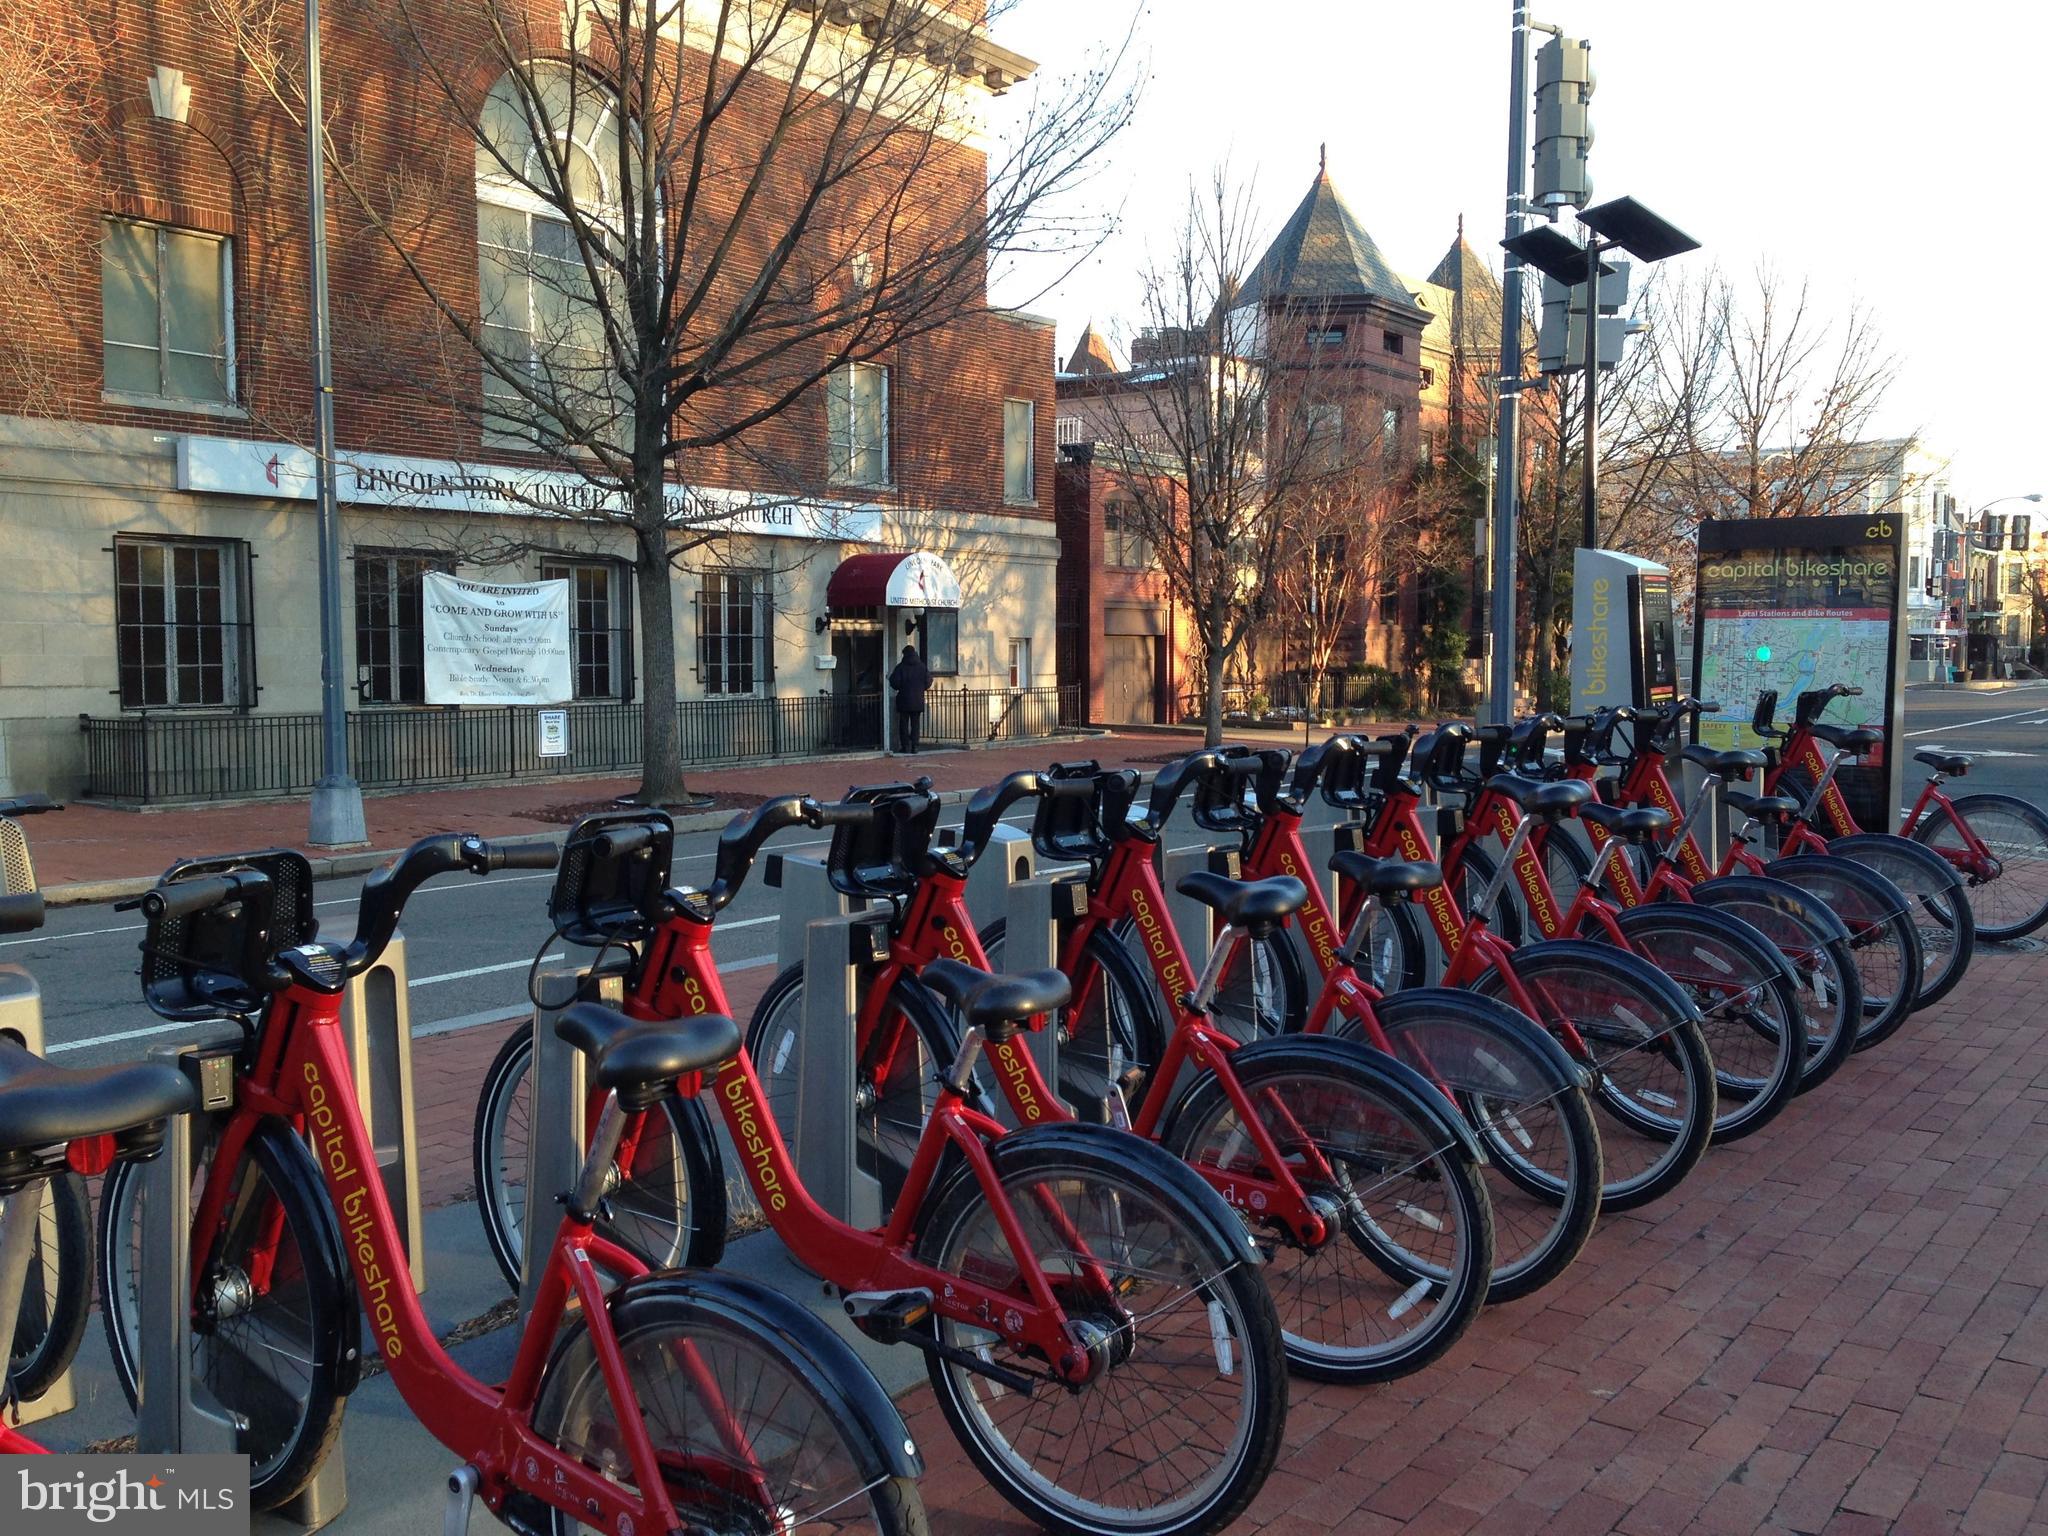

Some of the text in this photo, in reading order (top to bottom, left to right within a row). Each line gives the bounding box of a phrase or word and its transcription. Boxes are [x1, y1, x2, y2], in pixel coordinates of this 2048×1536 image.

[356, 467, 453, 497] LINCOLN
[468, 475, 523, 503] PARK
[534, 482, 605, 510] UNITED
[729, 502, 792, 526] CHURCH
[1706, 557, 1888, 582] capital bikeshare
[457, 582, 539, 595] YOU ARE INVITED
[890, 596, 908, 605] UNITED
[470, 607, 492, 617] AND
[493, 608, 523, 618] GROW
[524, 610, 547, 620] WITH
[1826, 609, 1854, 617] Routes
[484, 623, 519, 633] Sundays
[443, 632, 471, 642] Church
[502, 635, 512, 643] all
[1582, 577, 1609, 697] bikeshare
[427, 643, 480, 655] Contemporary
[482, 646, 508, 657] Gospel
[510, 647, 536, 658] Worship
[474, 663, 525, 673] Wednesdays
[493, 674, 514, 684] Noon
[1823, 785, 1852, 836] bikeshare
[1519, 859, 1556, 934] bikeshare
[1131, 888, 1173, 960] capital
[725, 1074, 787, 1212] bikeshare
[303, 1061, 402, 1359] capital bikeshare
